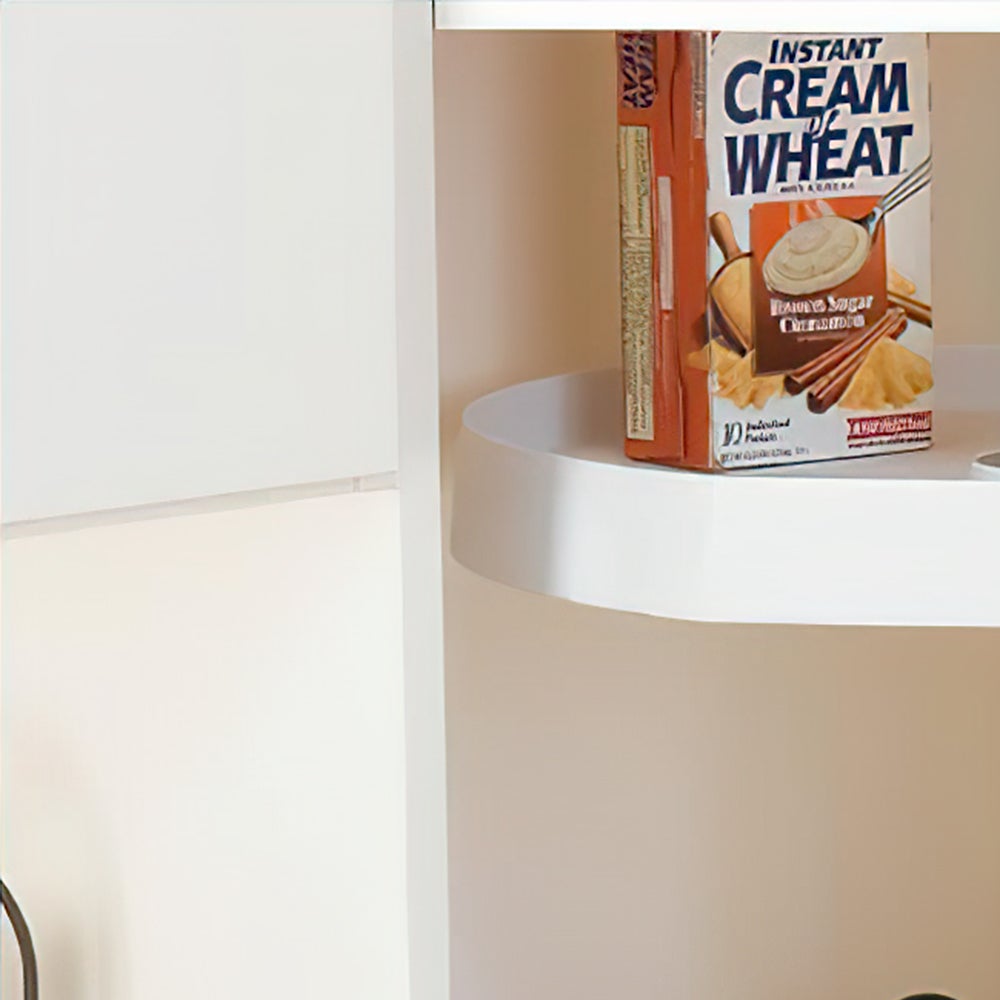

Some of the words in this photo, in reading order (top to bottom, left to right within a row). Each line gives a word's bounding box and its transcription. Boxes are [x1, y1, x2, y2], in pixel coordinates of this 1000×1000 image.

[768, 37, 884, 64] INSTANT
[723, 59, 911, 125] CREAM
[803, 108, 841, 139] of
[723, 123, 914, 197] WHEAT
